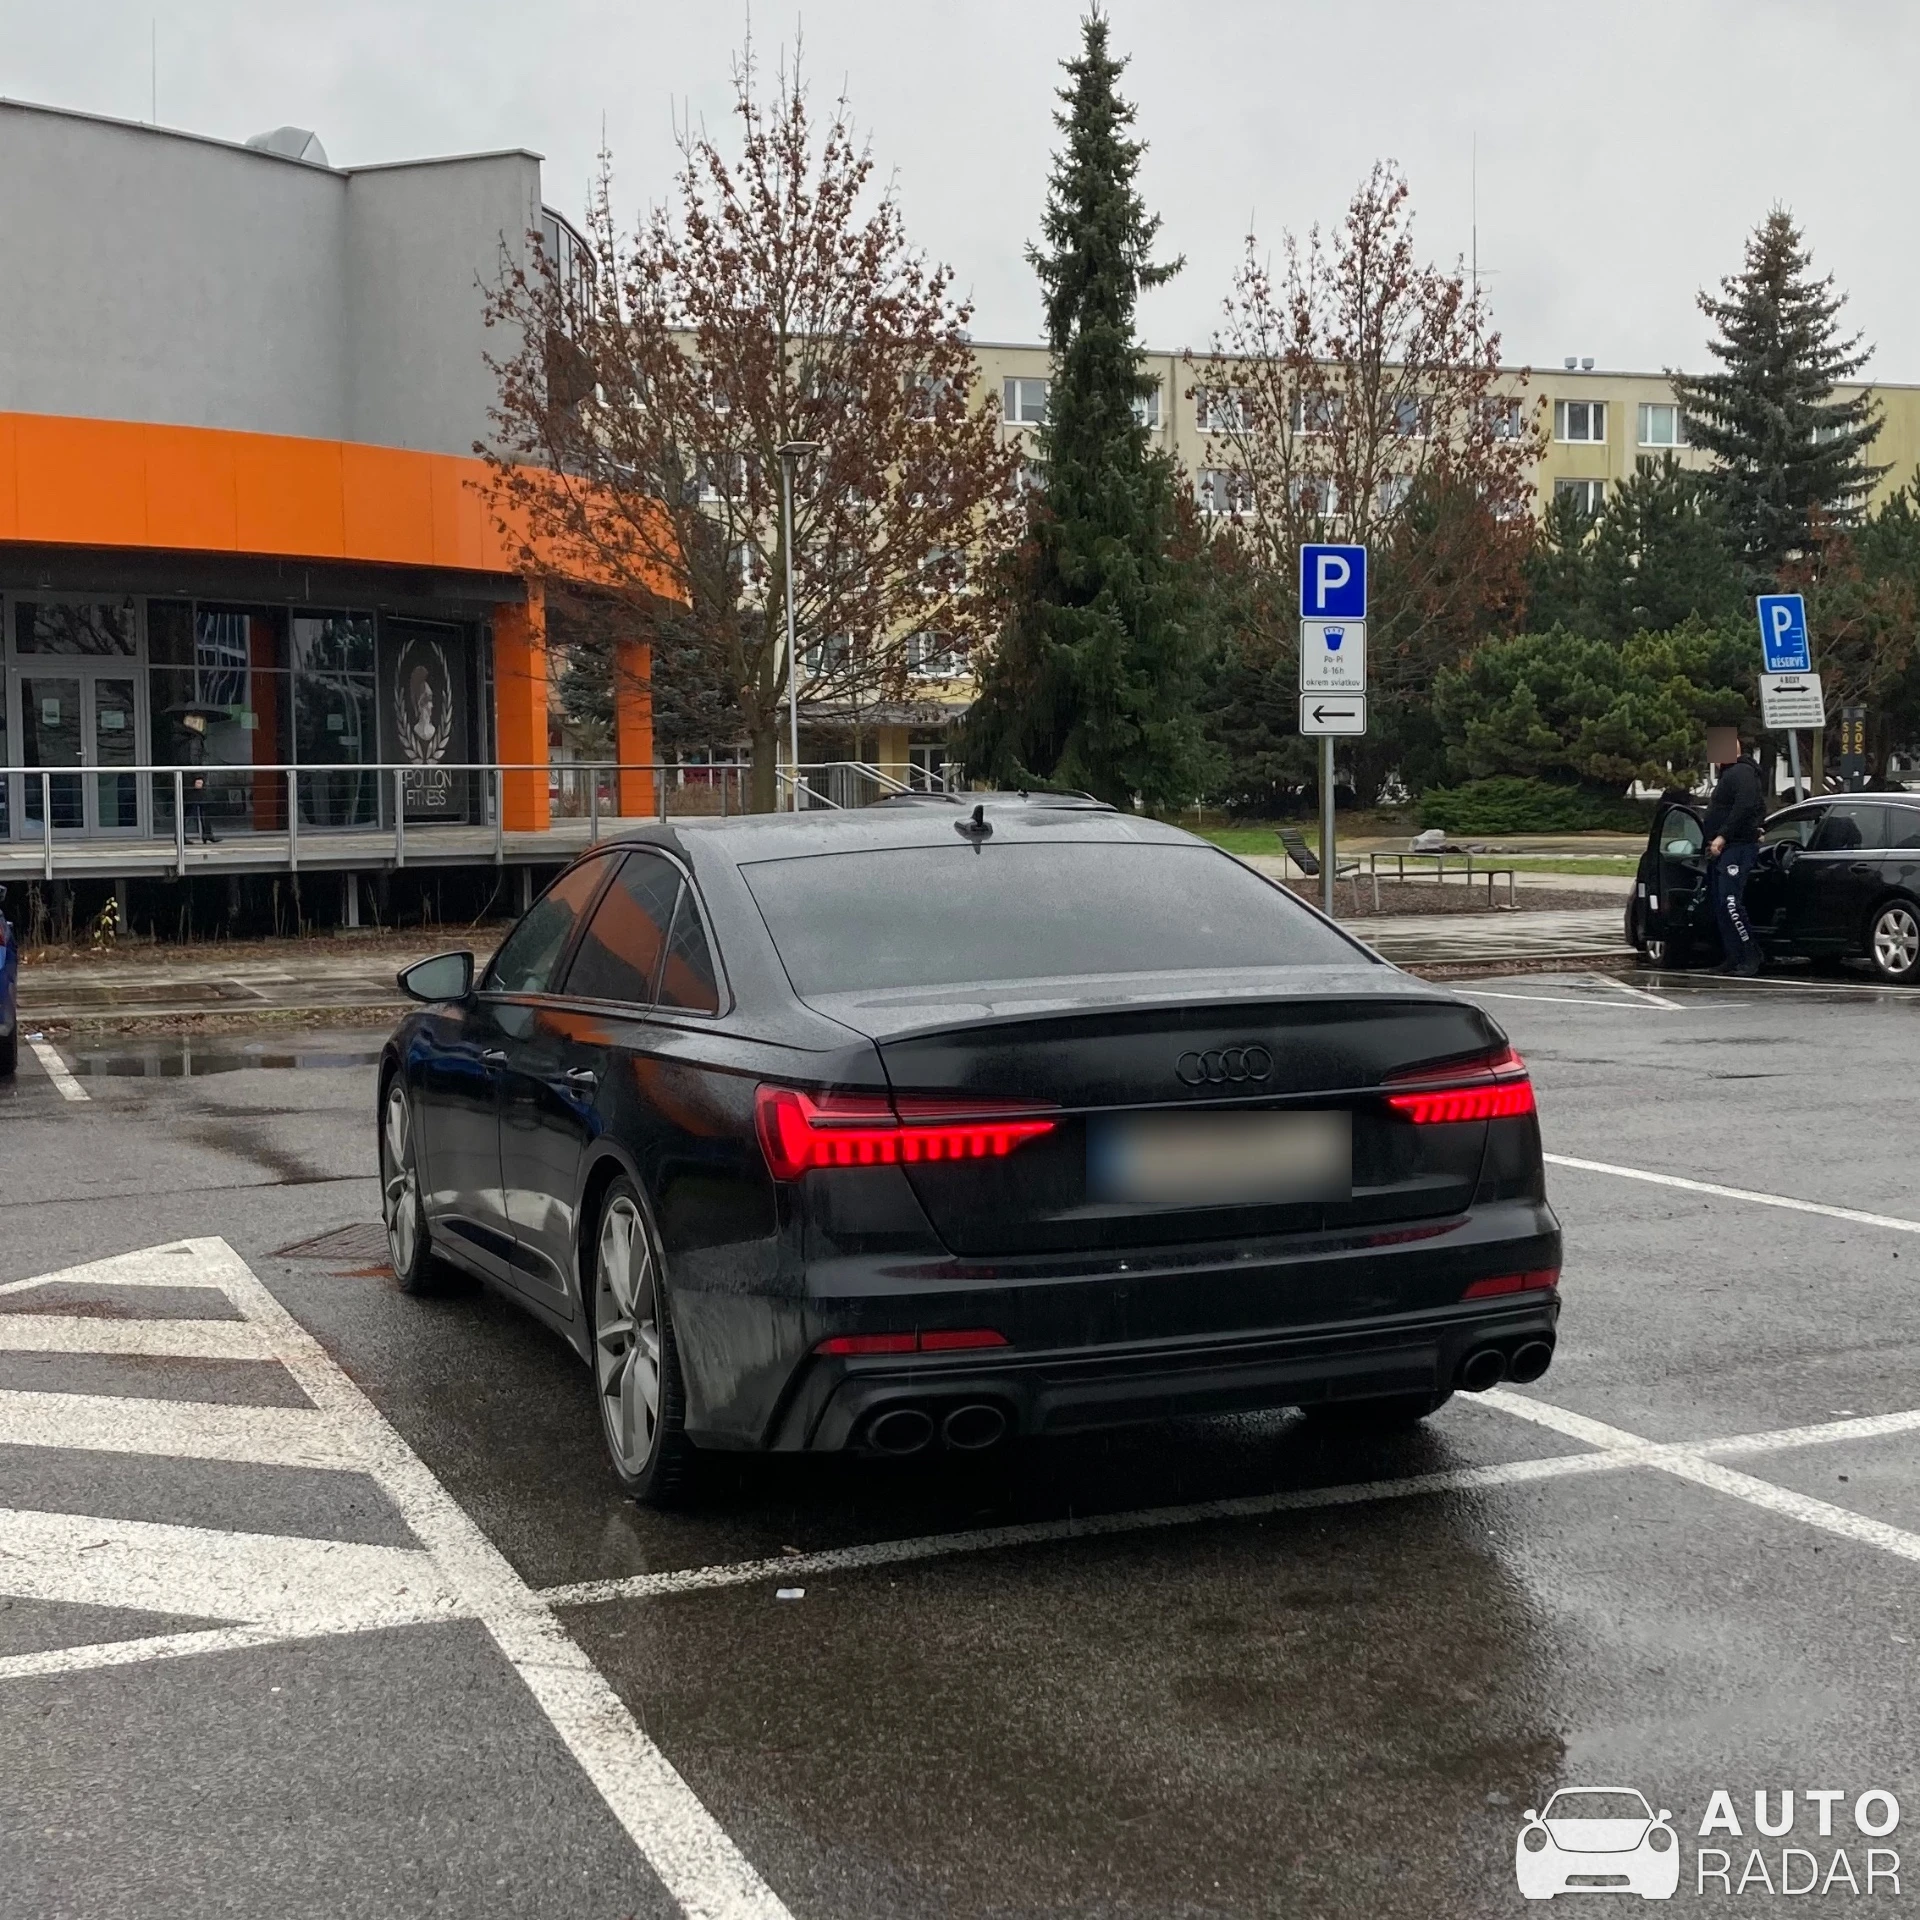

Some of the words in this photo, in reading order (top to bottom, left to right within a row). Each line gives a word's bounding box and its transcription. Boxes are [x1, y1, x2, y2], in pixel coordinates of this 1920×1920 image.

[1317, 555, 1350, 608] P
[1771, 605, 1793, 647] P
[1306, 678, 1328, 686] okrem
[1331, 678, 1361, 687] sviatkov
[1842, 721, 1850, 755] SOS
[1854, 721, 1863, 755] SOS
[1726, 894, 1740, 920] POLO
